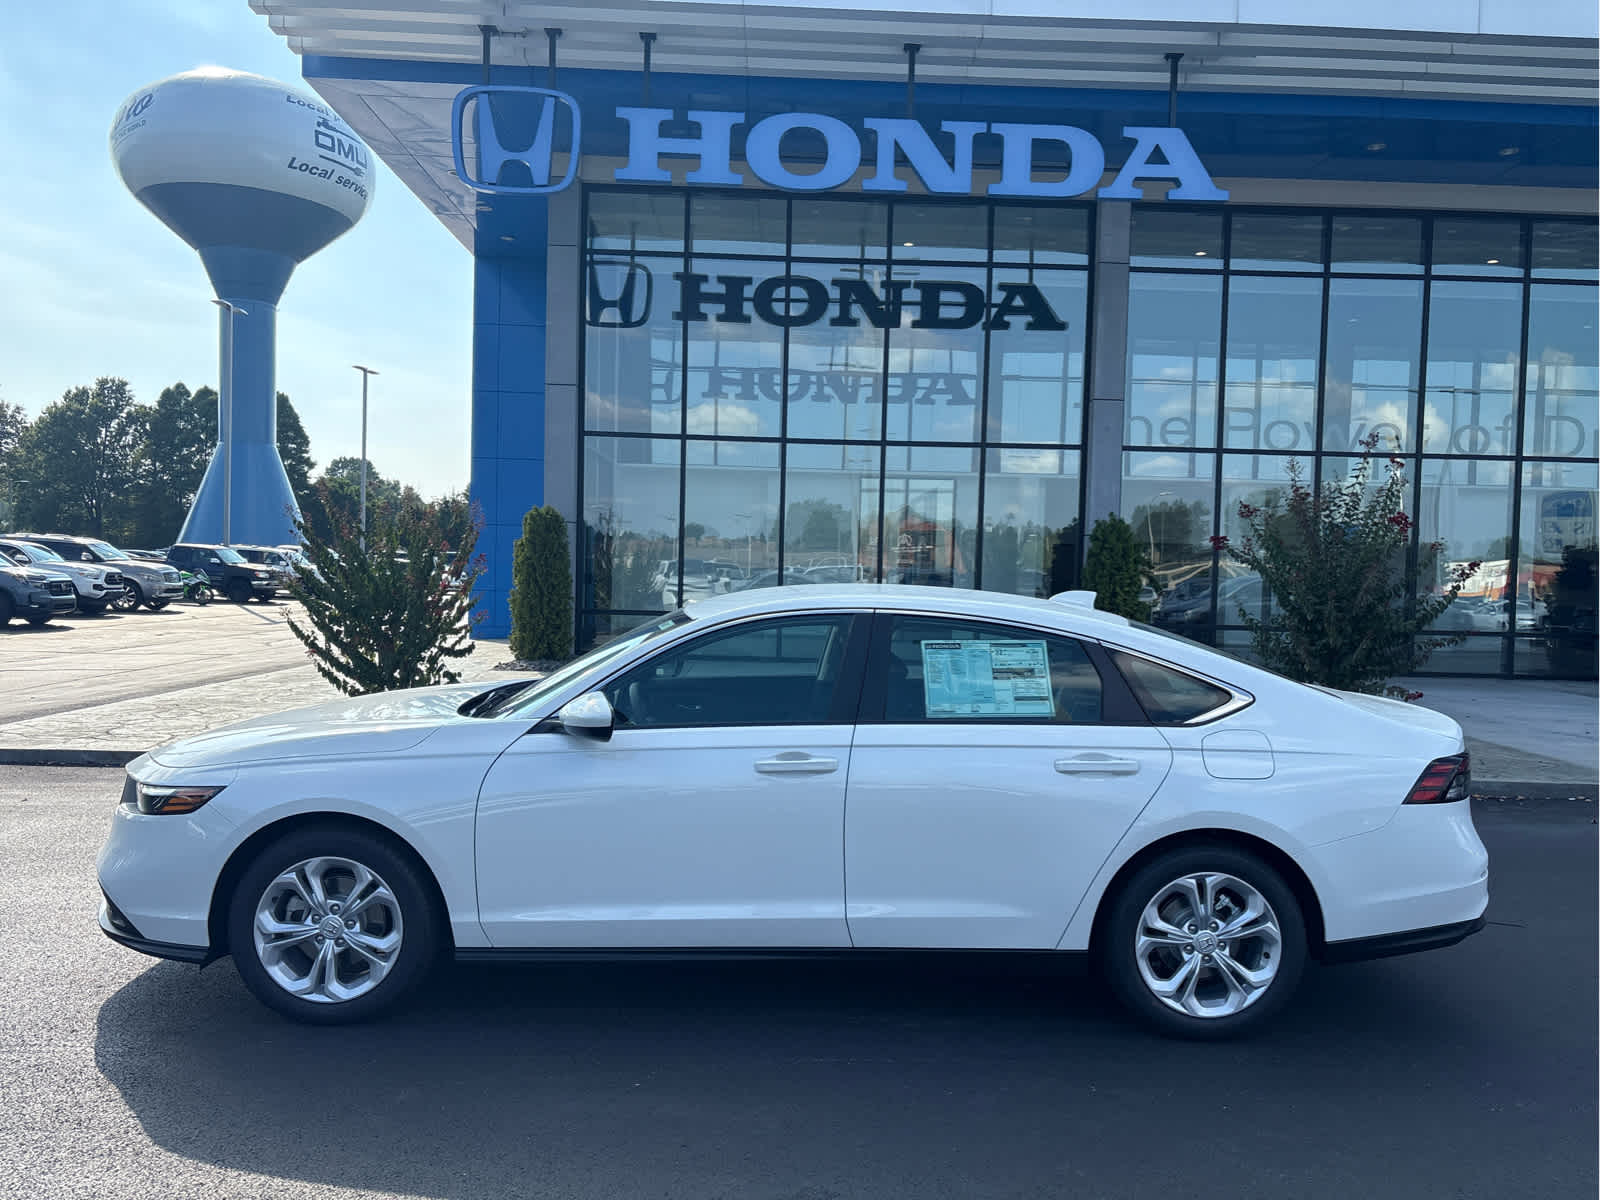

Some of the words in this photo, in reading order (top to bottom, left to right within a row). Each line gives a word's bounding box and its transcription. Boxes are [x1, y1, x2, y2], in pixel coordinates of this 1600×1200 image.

[287, 156, 335, 180] Local
[614, 105, 1229, 201] HONDA
[672, 271, 1069, 332] HONDA
